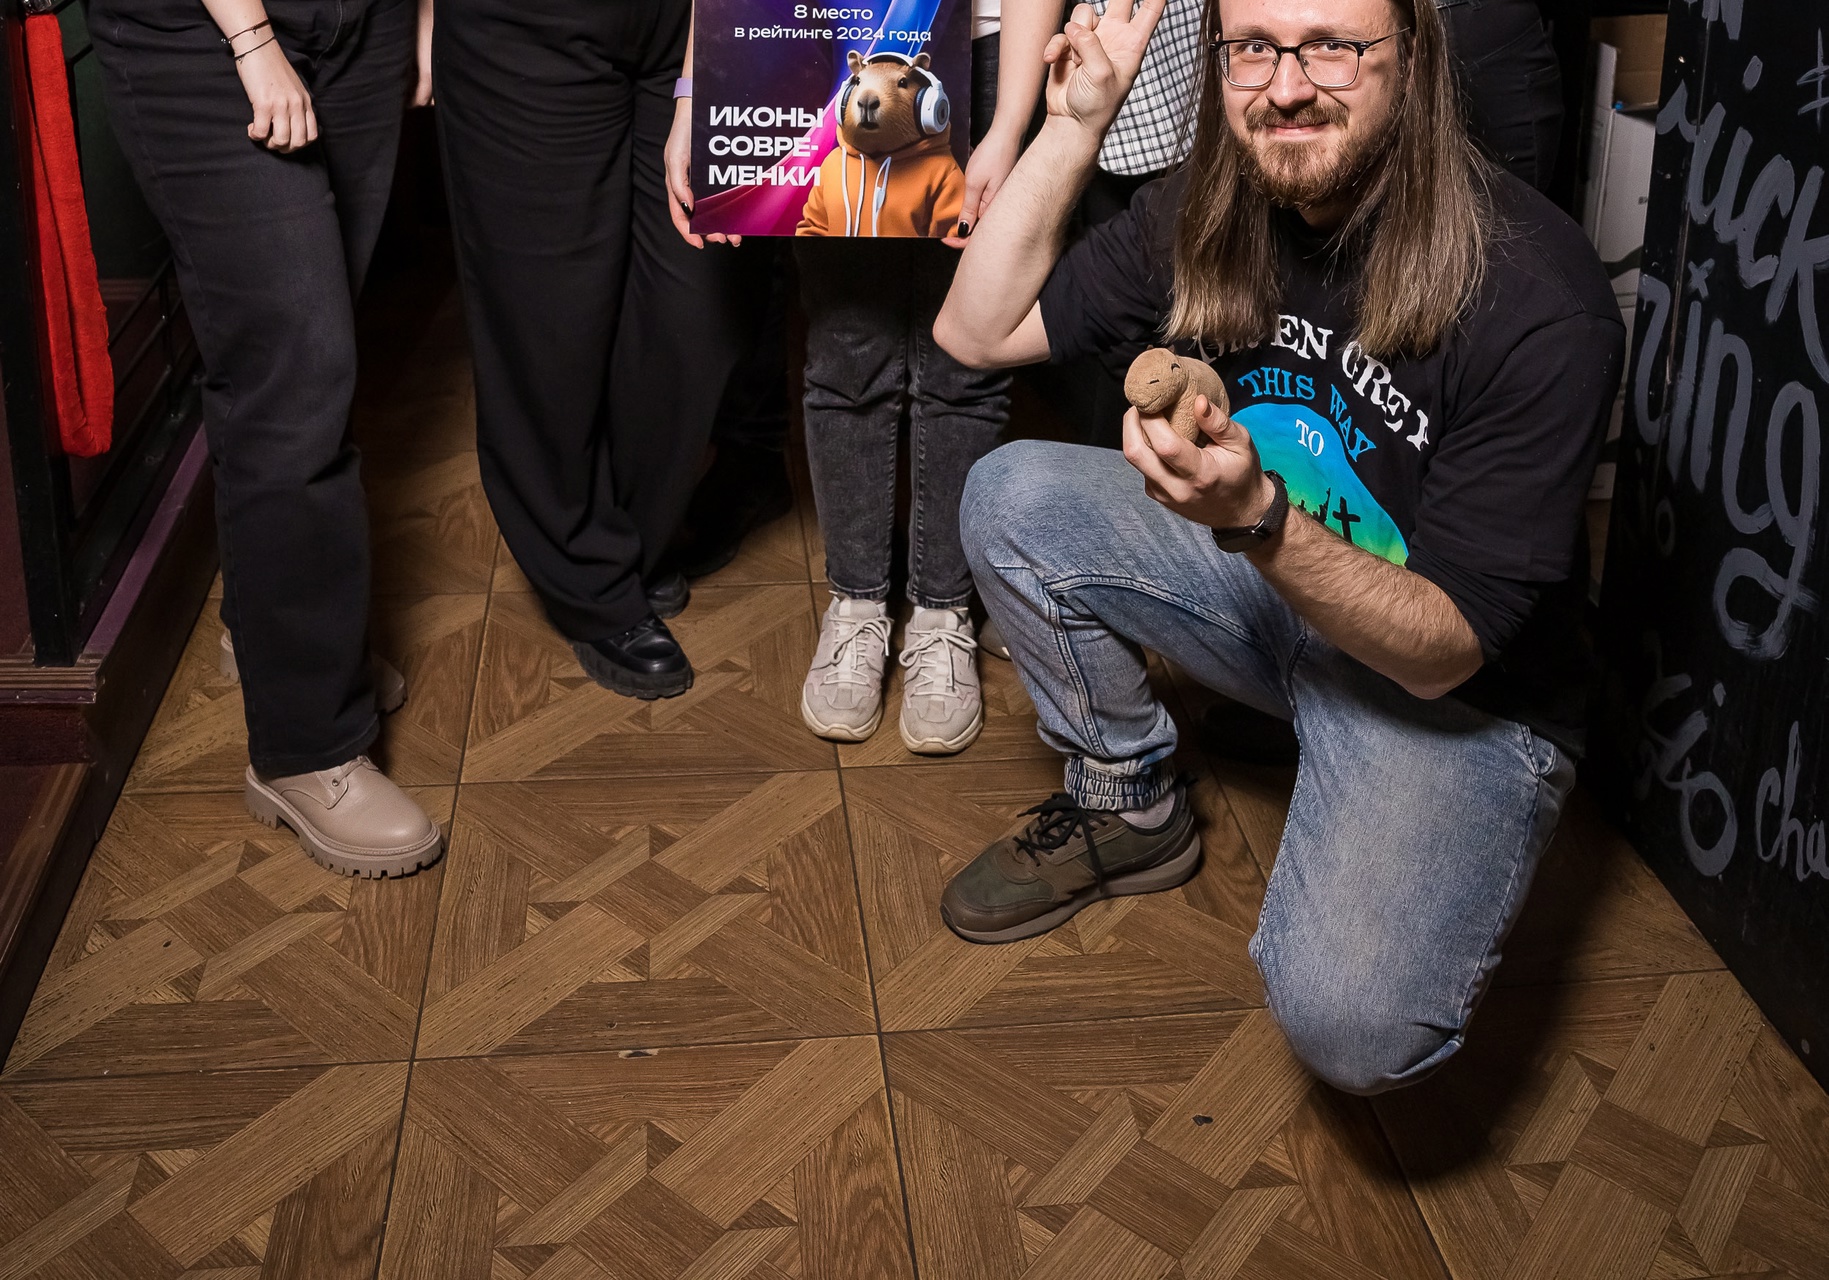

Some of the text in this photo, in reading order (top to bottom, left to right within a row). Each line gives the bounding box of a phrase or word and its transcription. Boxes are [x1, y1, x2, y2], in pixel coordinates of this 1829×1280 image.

[793, 4, 874, 20] 8 место
[734, 24, 932, 42] в рейтинге 2024 года
[709, 105, 824, 128] ИКОНЫ
[708, 135, 819, 157] СОВРЕ-
[708, 164, 821, 186] МЕНКИ
[1237, 366, 1377, 463] THIS WAY
[1295, 419, 1325, 457] TO
